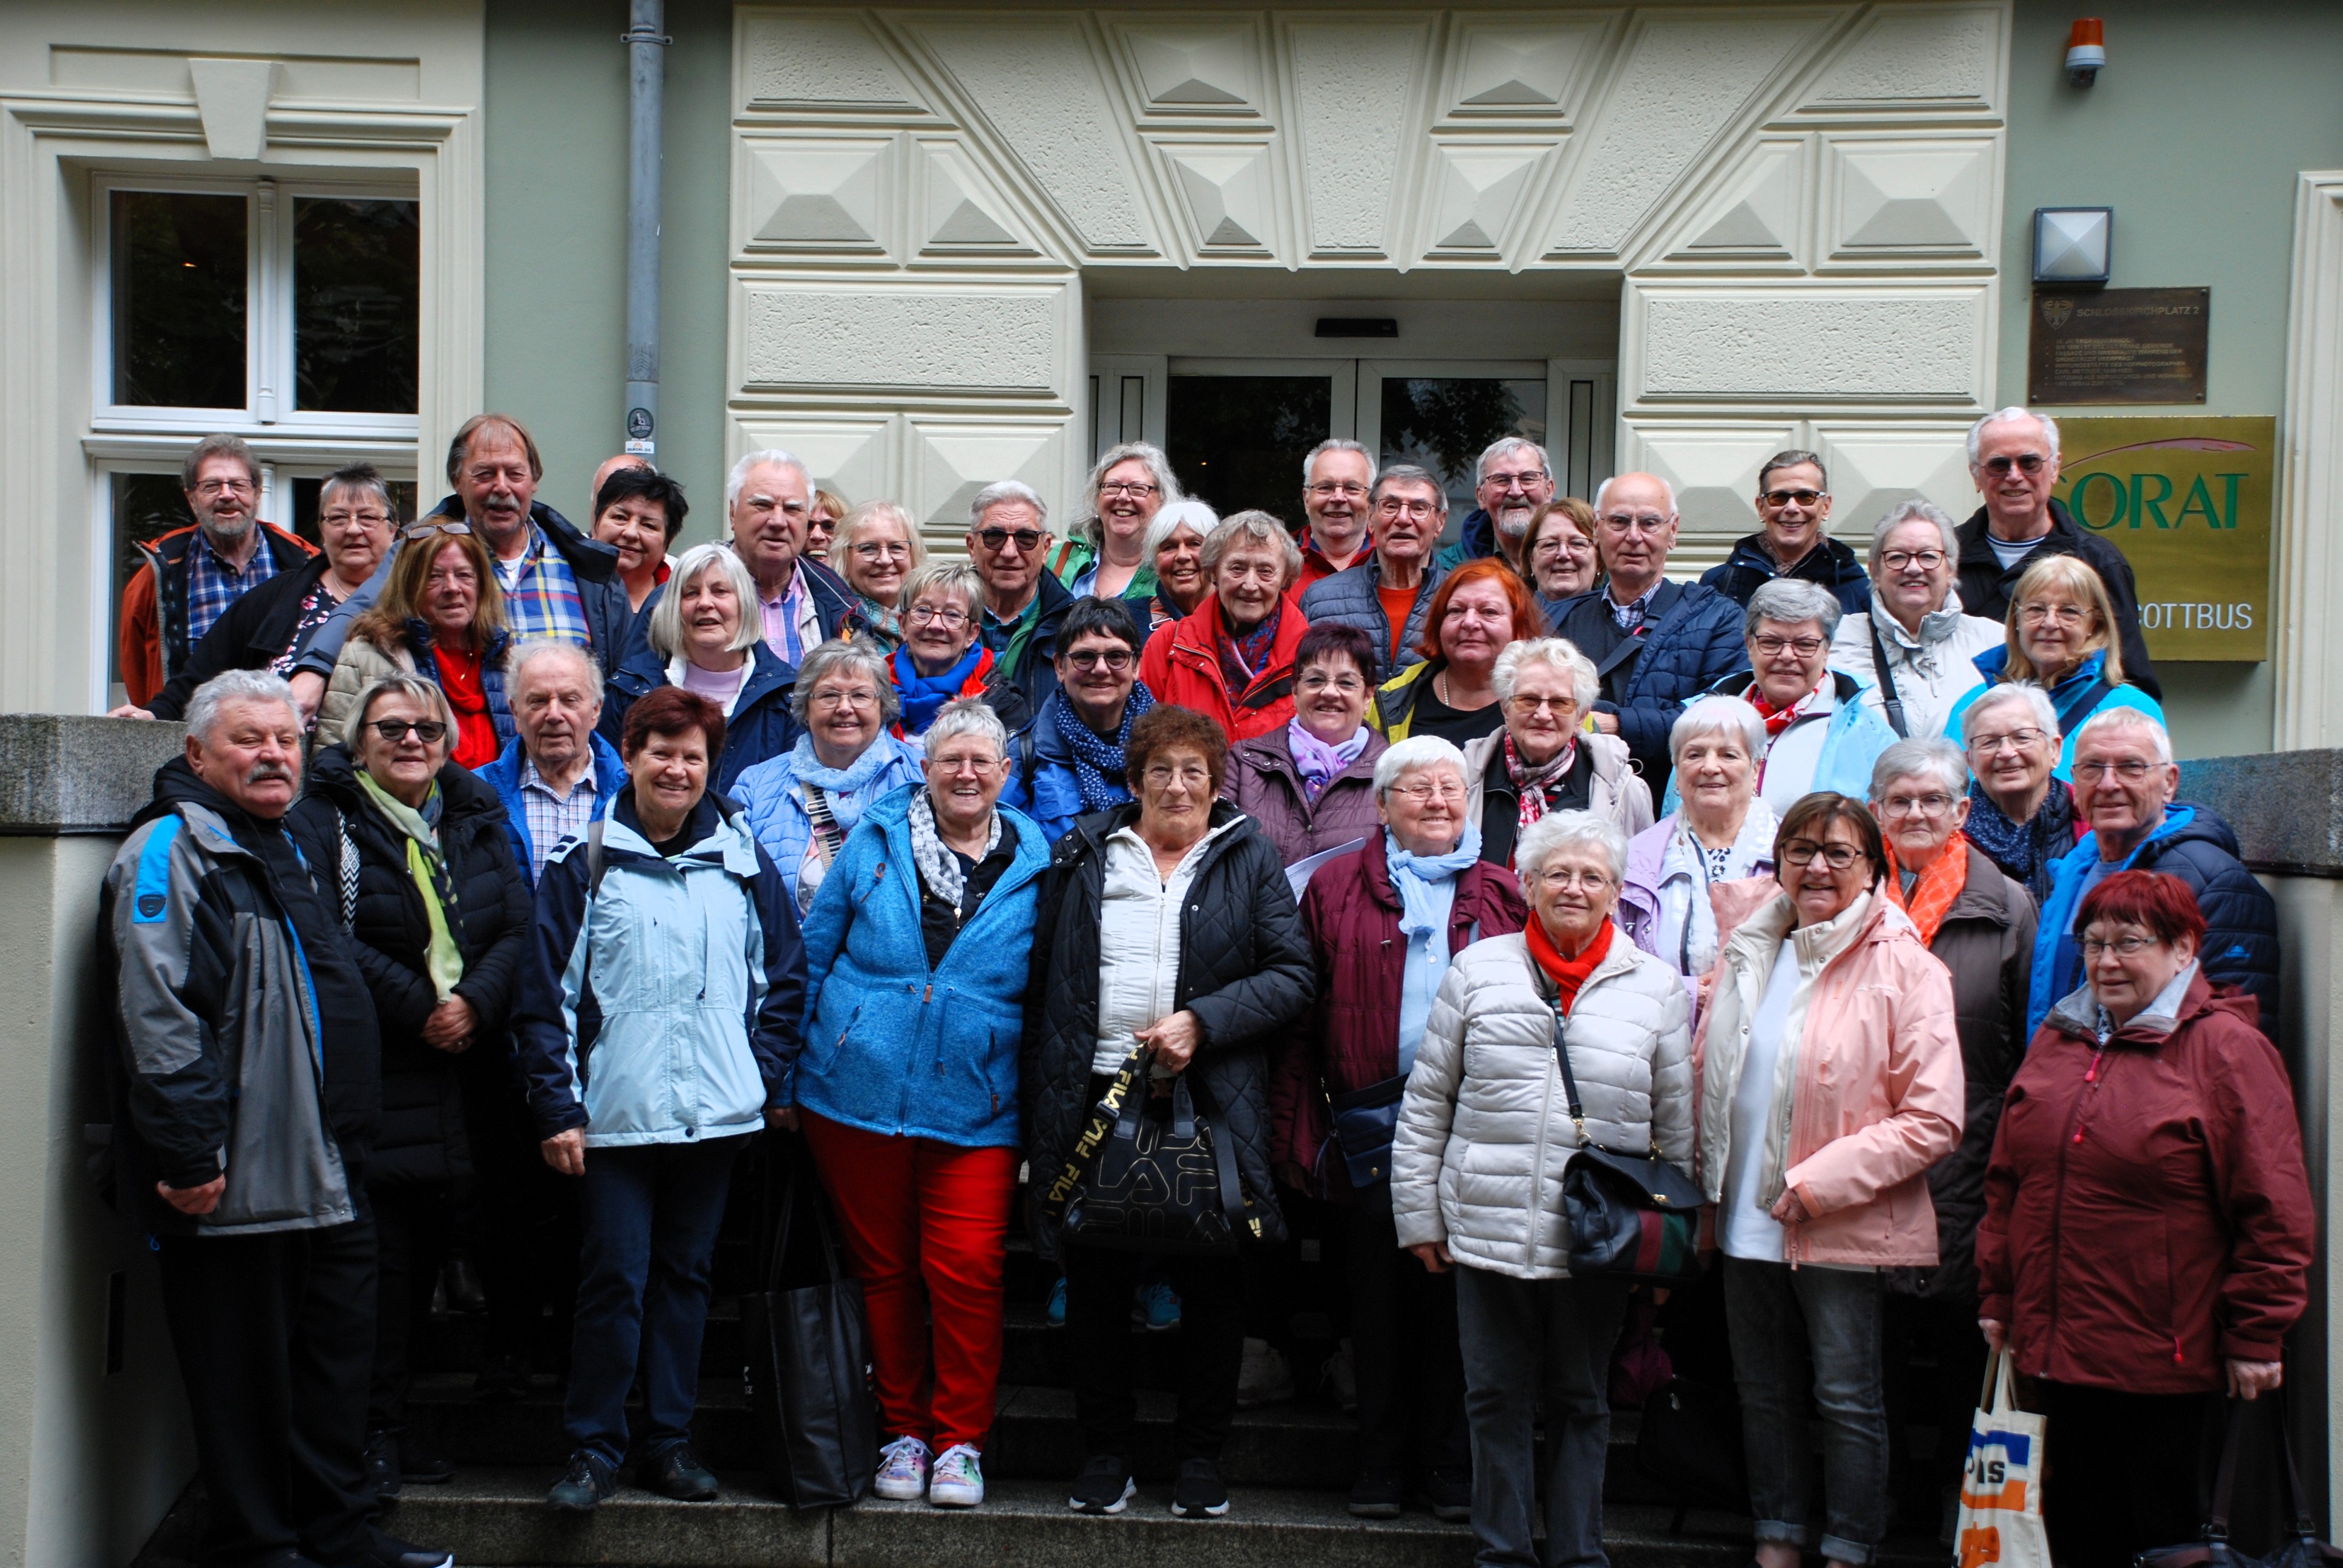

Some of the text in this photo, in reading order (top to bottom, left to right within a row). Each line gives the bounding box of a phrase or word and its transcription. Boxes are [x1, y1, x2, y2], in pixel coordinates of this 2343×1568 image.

[2077, 307, 2191, 317] SCHLOSSKIRCHPLATZ
[2137, 602, 2253, 630] OTTBUS
[1048, 1162, 1081, 1202] FILA
